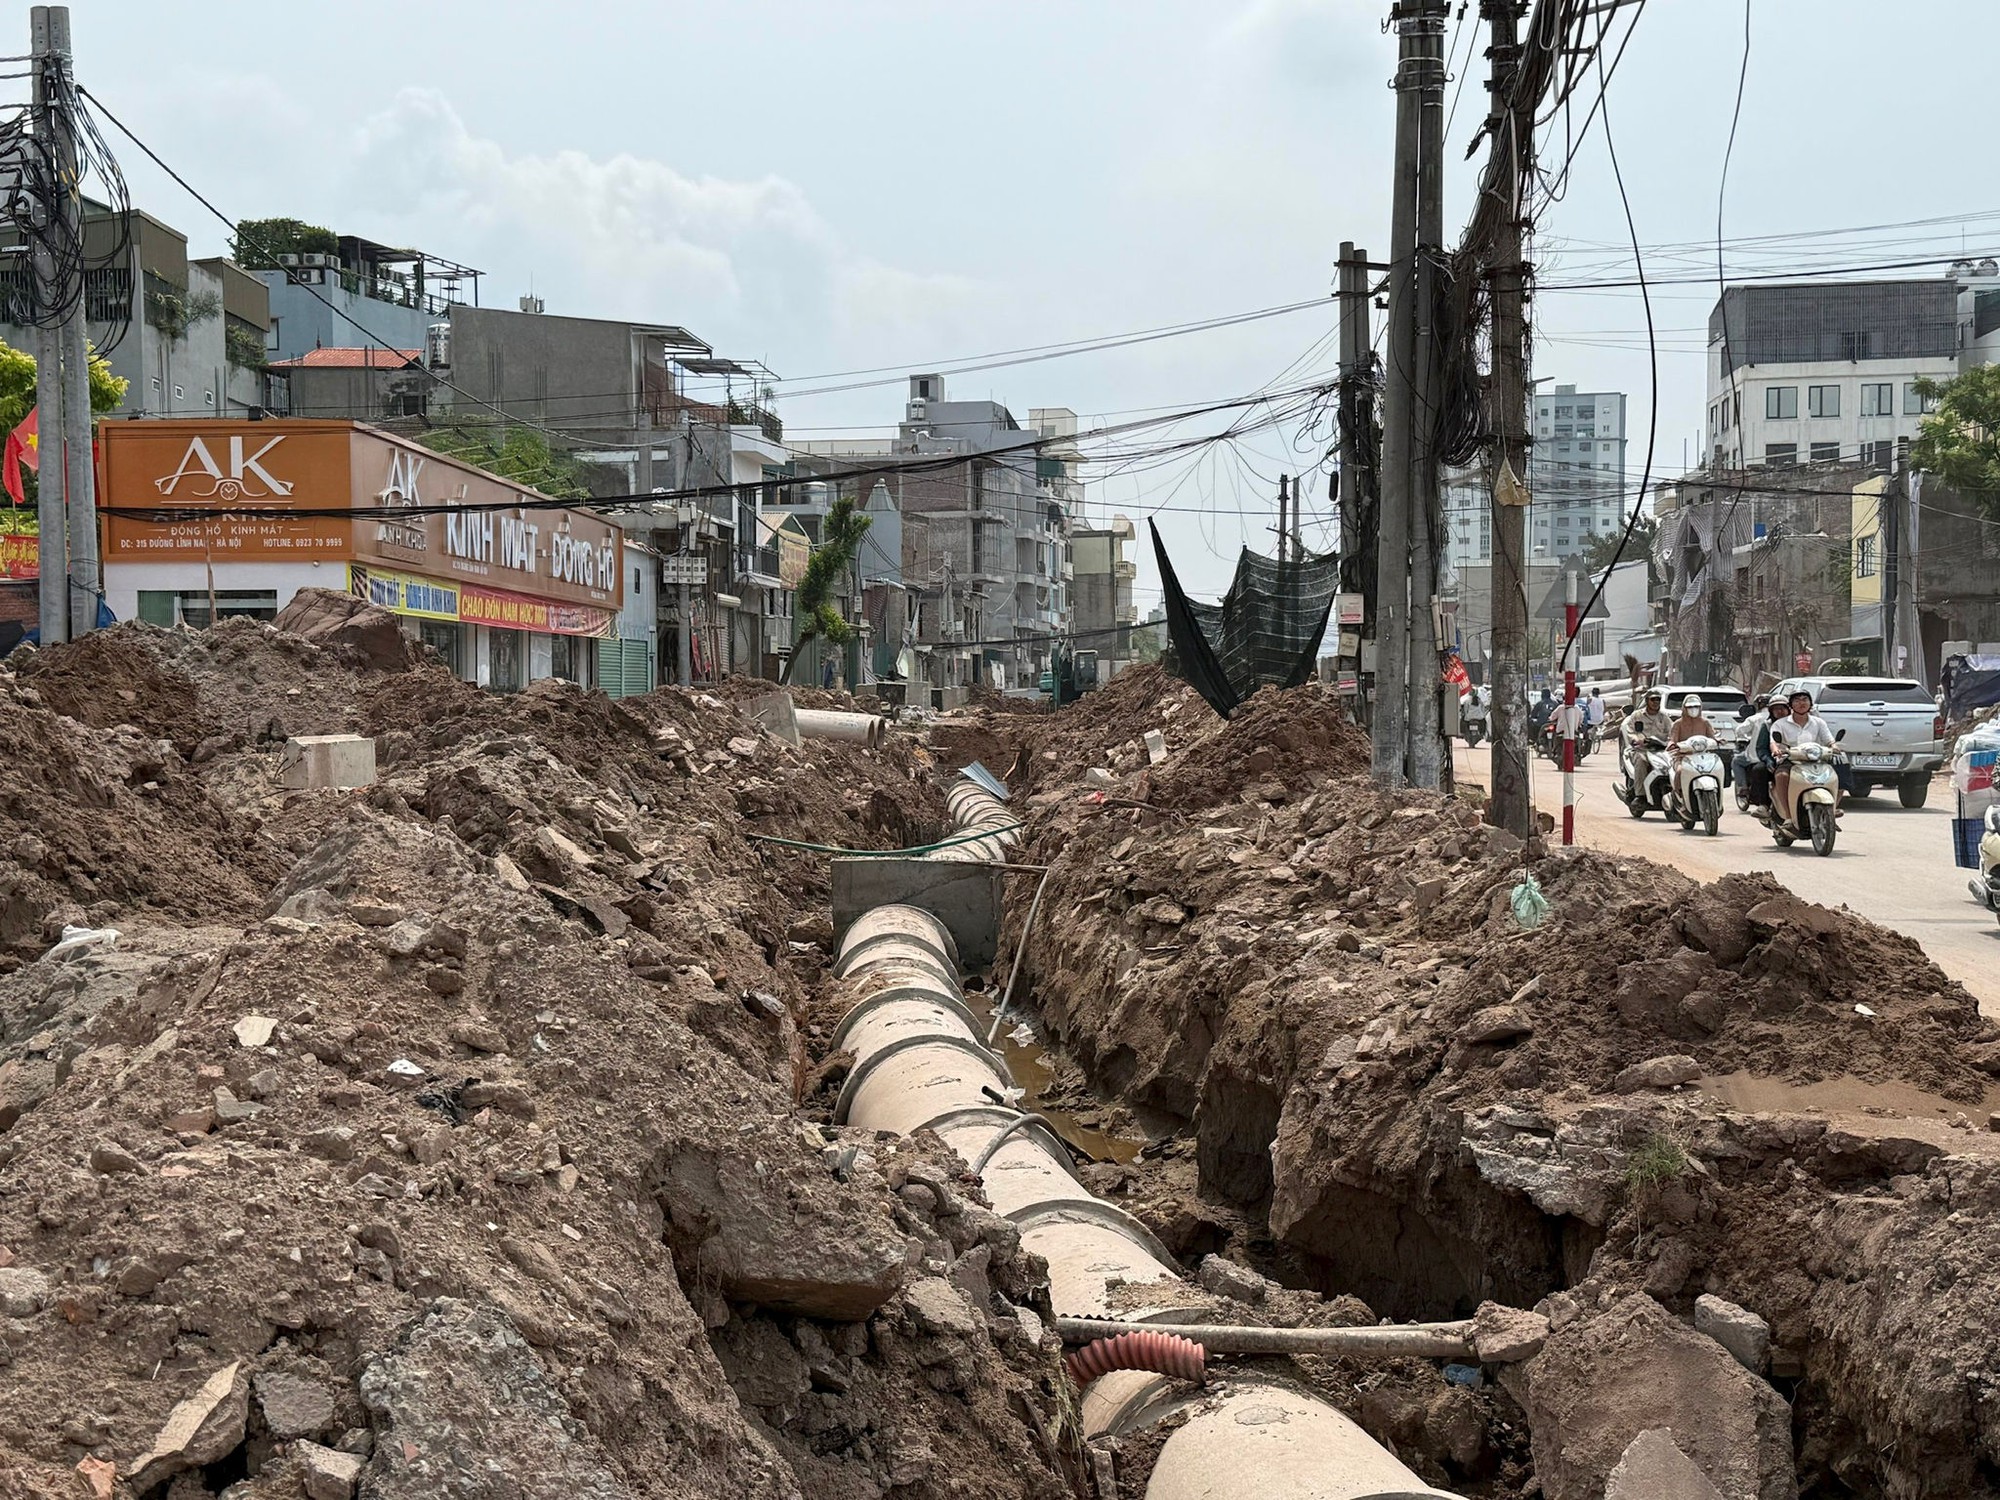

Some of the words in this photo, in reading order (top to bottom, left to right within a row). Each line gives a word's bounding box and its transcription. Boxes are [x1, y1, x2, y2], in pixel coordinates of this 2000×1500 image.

[230, 524, 256, 535] KÍNH
[380, 524, 402, 546] ANH
[404, 531, 428, 551] KHOA
[446, 484, 494, 563] KÍNH
[501, 495, 538, 573] MẮT
[552, 514, 593, 587] ĐỒNG
[596, 529, 615, 592] HỒ
[461, 592, 482, 618] CHÀO
[485, 595, 500, 619] ĐÓN
[502, 597, 518, 622] NĂM
